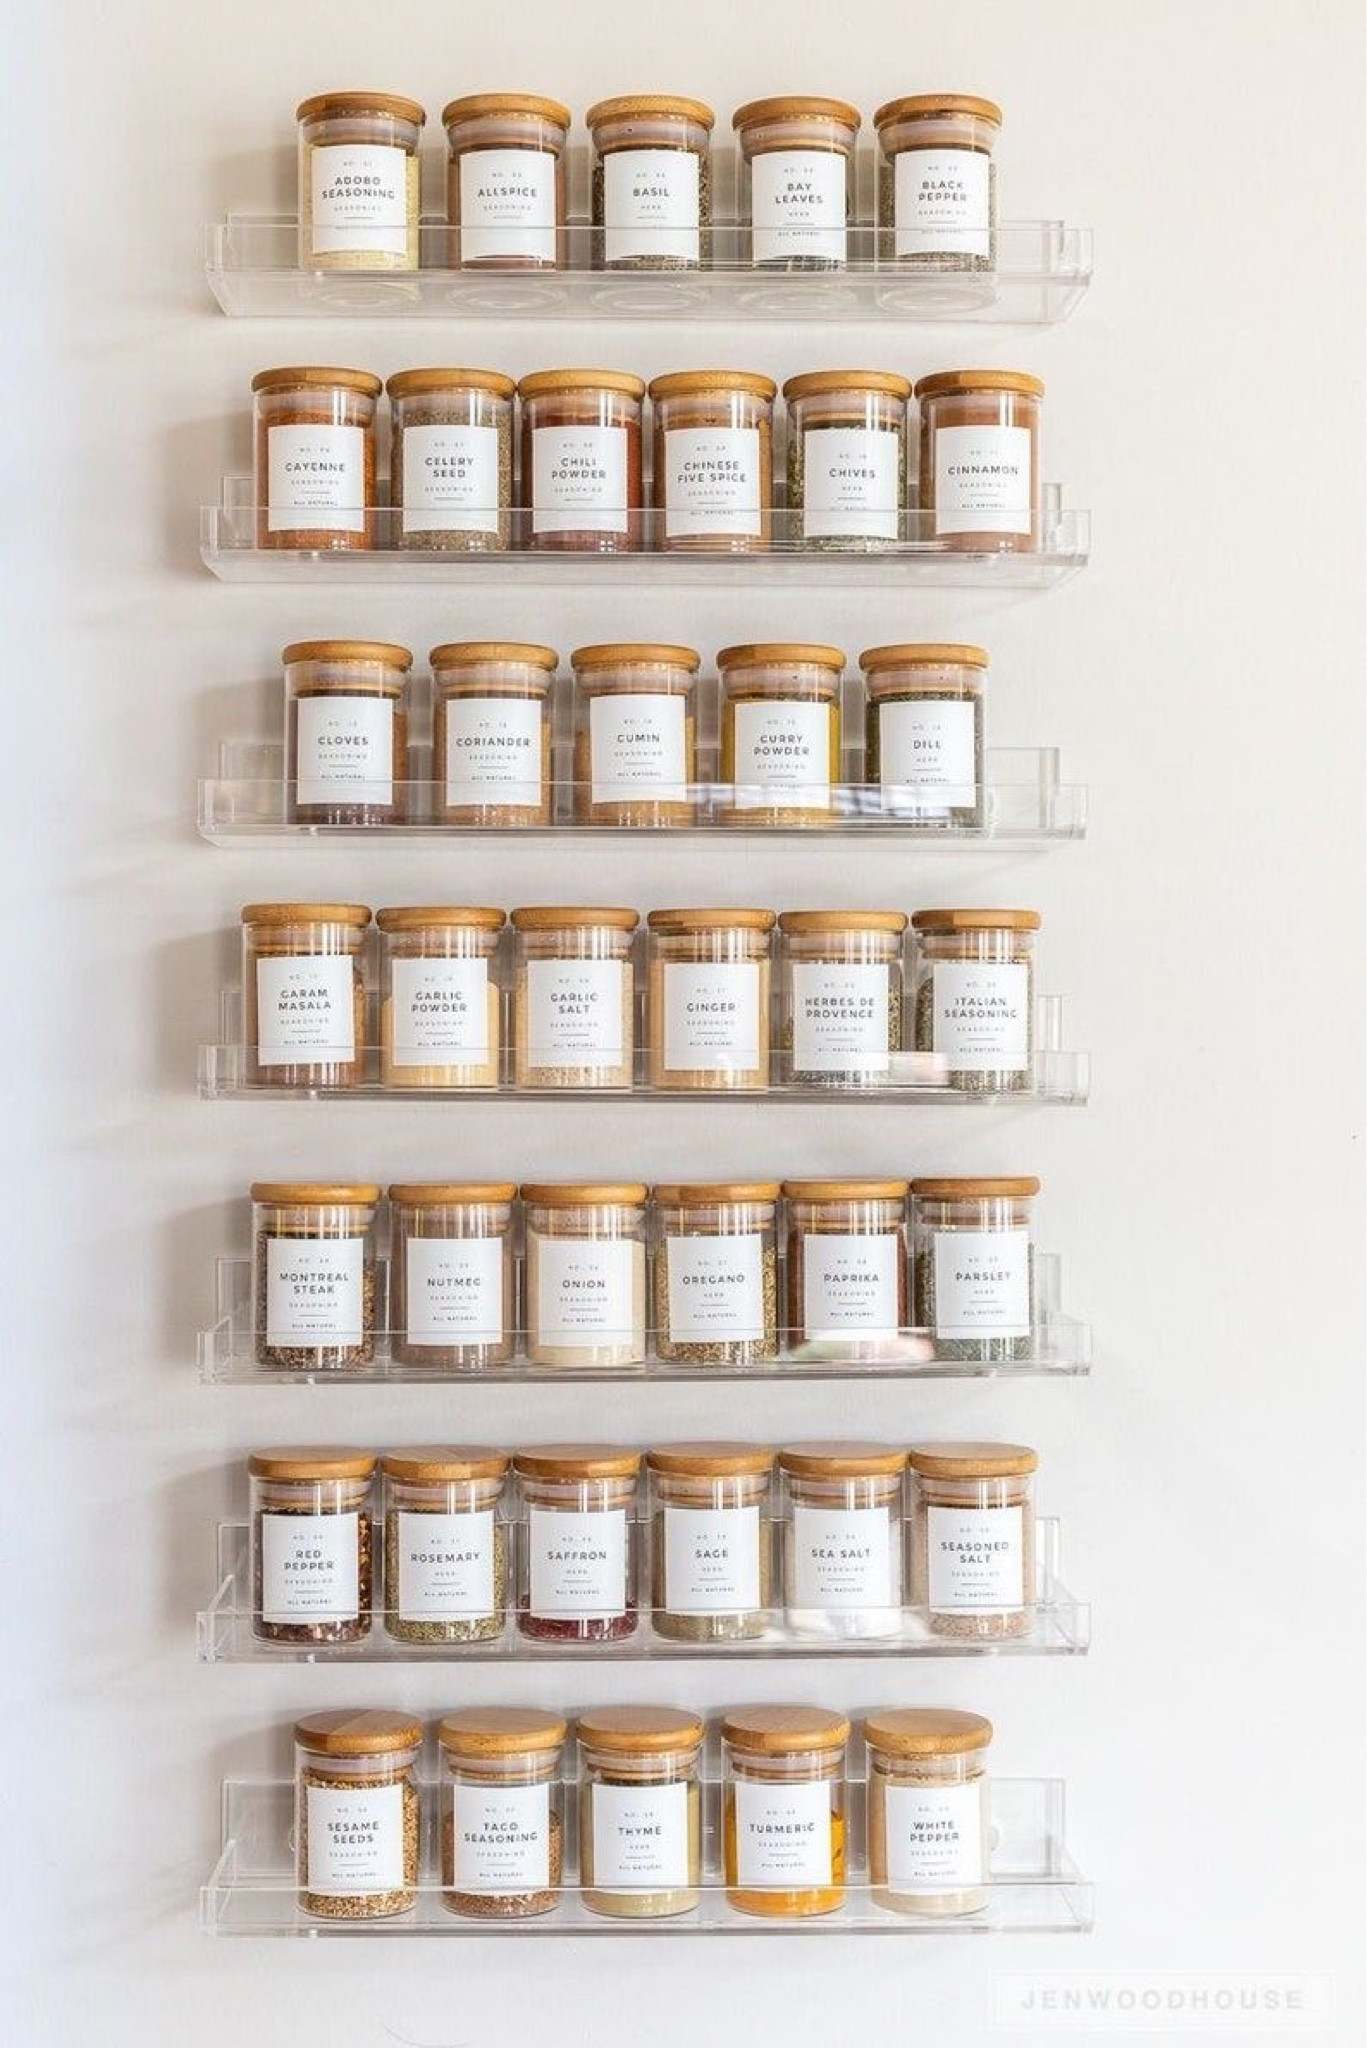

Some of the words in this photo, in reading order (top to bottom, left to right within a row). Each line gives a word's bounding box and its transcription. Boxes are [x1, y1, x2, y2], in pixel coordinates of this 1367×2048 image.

[334, 176, 382, 186] ADOBO
[921, 180, 965, 191] BLACK
[477, 187, 538, 198] ALLSPICE
[632, 187, 671, 197] BASIL
[786, 182, 812, 192] BAY
[321, 188, 396, 200] SEASONING
[774, 194, 824, 205] LEAVES
[918, 192, 968, 202] PEPPER
[284, 461, 346, 473] CAYENNE
[424, 457, 475, 467] CELERY
[560, 457, 599, 468] CHILI
[683, 460, 740, 472] CHINESE
[431, 468, 467, 479] SEED
[550, 469, 607, 480] POWDER
[828, 467, 877, 479] CHIVES
[947, 465, 1020, 477] CINNAMON
[677, 473, 705, 484] FIVE
[709, 472, 747, 483] SPICE
[317, 736, 369, 746] CLOVES
[455, 737, 531, 747] CORIANDER
[616, 733, 661, 744] CUMIN
[759, 734, 803, 744] CURRY
[912, 739, 942, 750] DILL
[752, 746, 810, 757] POWDER
[280, 988, 329, 999] GARAM
[414, 990, 464, 1002] GARLIC
[549, 991, 599, 1003] GARLIC
[277, 1000, 332, 1012] MASALA
[804, 997, 855, 1008] HERBES
[859, 997, 876, 1007] DE
[954, 996, 1007, 1007] ITALIAN
[410, 1002, 469, 1014] POWDER
[558, 1004, 590, 1015] SALT
[686, 1002, 736, 1013] GINGER
[805, 1008, 874, 1020] PROVENCE
[943, 1008, 1018, 1020] SEASONING
[279, 1271, 350, 1283] MONTREAL
[681, 1273, 746, 1286] OREGANO
[823, 1272, 880, 1284] PAPRIKA
[955, 1270, 1013, 1283] PARSLEY
[426, 1277, 482, 1288] NUTMEG
[561, 1278, 607, 1289] ONION
[293, 1283, 335, 1295] STEAK
[940, 1540, 1009, 1553] SEASONED
[295, 1548, 323, 1560] RED
[410, 1551, 482, 1563] ROSEMARY
[547, 1550, 608, 1561] SAFFRON
[695, 1549, 730, 1559] SAGE
[810, 1548, 837, 1559] SEA
[840, 1548, 871, 1559] SALT
[958, 1554, 991, 1564] SALT
[283, 1560, 335, 1572] PEPPER
[327, 1820, 380, 1832] SESAME
[483, 1821, 519, 1832] TACO
[617, 1825, 662, 1837] THYME
[748, 1822, 815, 1835] TURMERIC
[912, 1820, 955, 1831] WHITE
[332, 1834, 375, 1844] SEEDS
[463, 1831, 539, 1844] SEASONING
[909, 1832, 960, 1843] PEPPER
